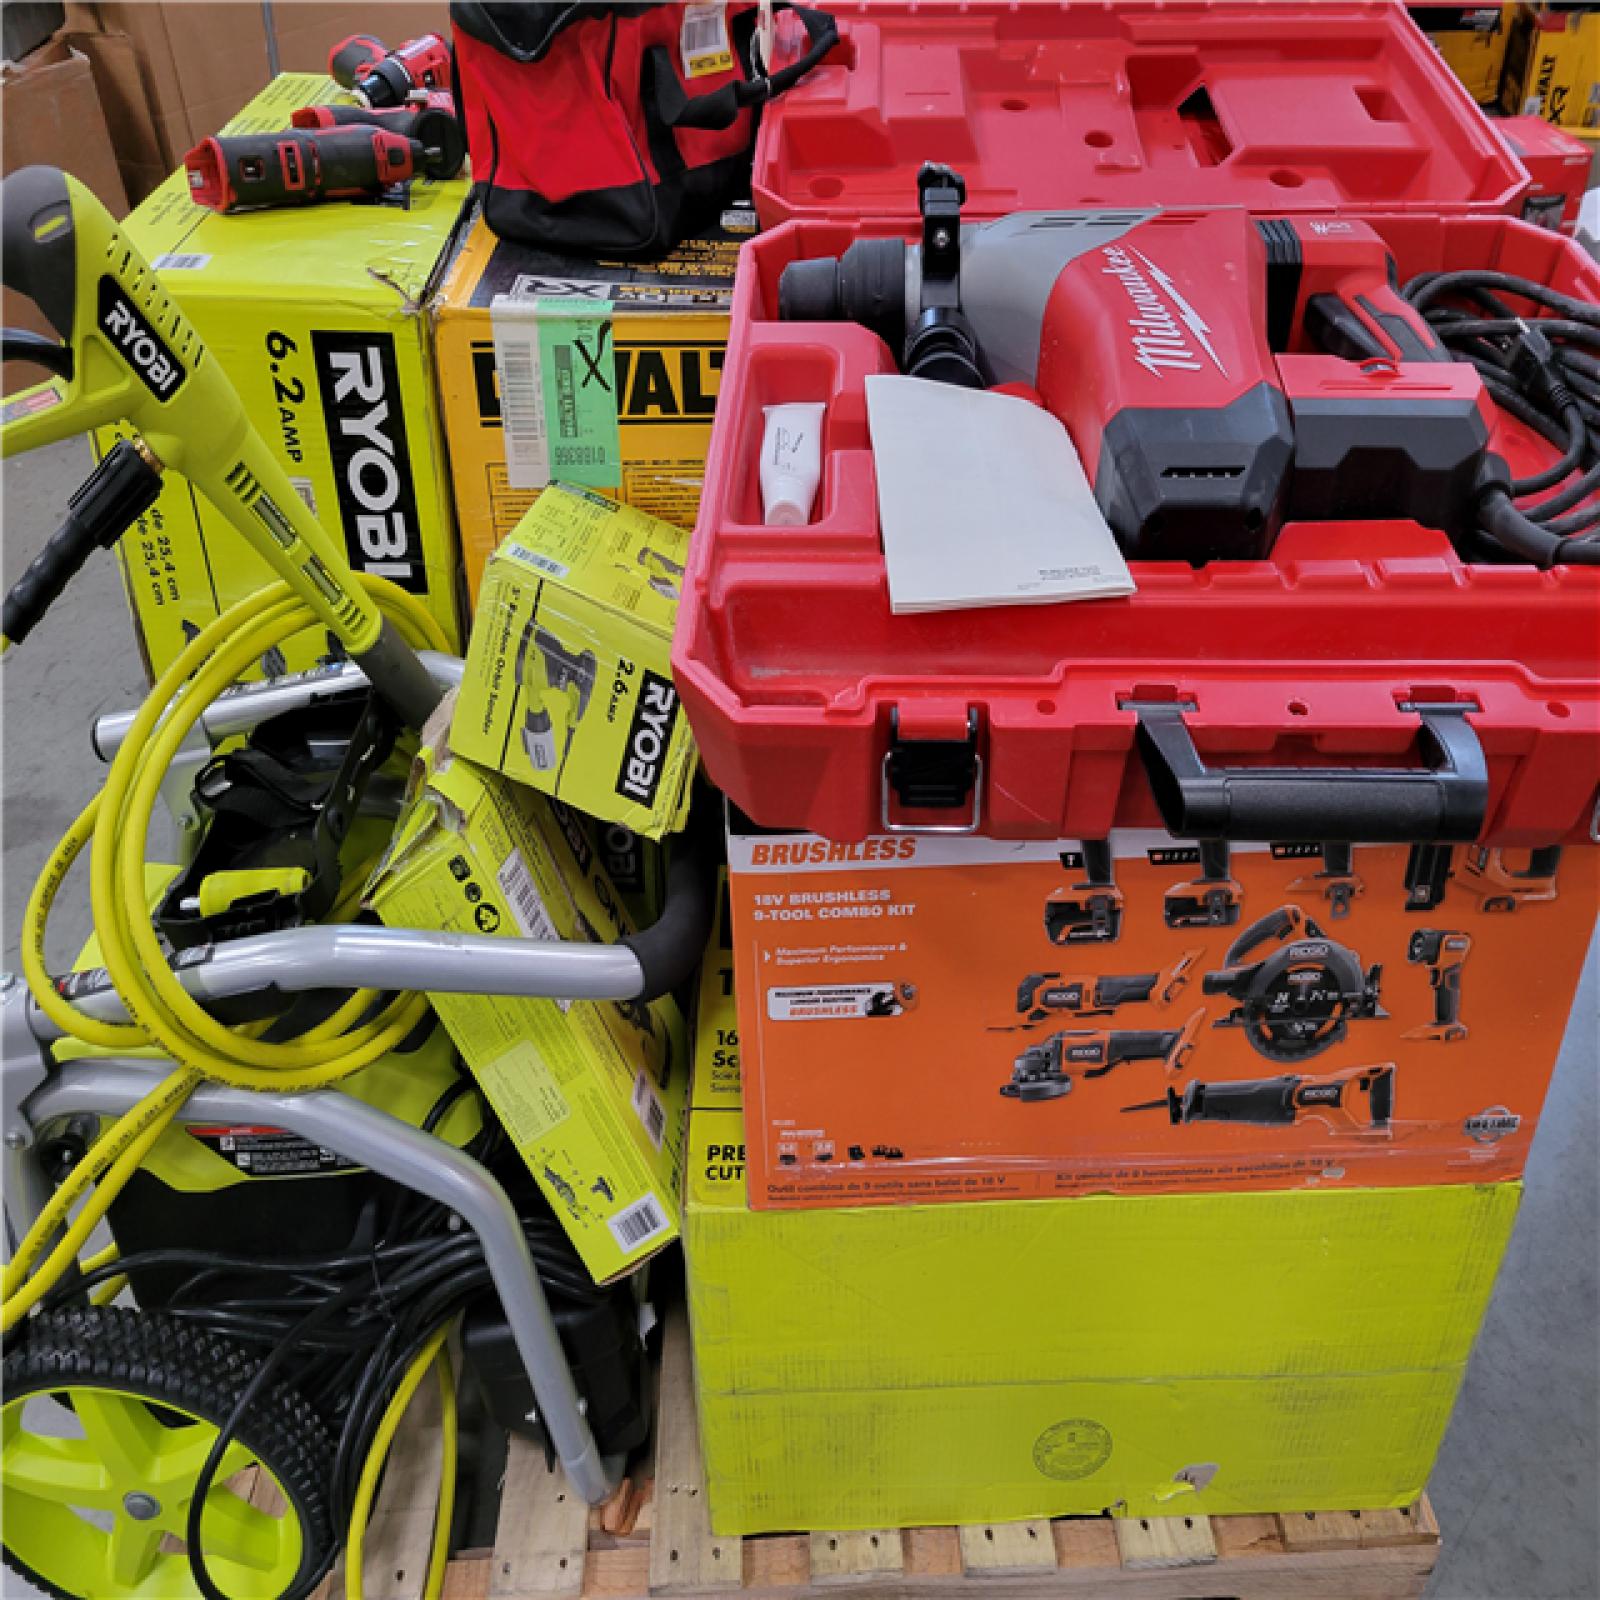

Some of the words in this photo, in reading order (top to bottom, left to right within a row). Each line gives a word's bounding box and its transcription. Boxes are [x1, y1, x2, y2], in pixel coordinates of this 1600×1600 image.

[105, 300, 179, 390] RYOBI
[1102, 246, 1200, 378] Milwaukee
[329, 347, 413, 577] RYOBI
[625, 683, 674, 797] RYOBI
[751, 837, 916, 865] BRUSHLESS
[754, 894, 784, 906] 18V
[789, 889, 891, 905] BRUSHLESS
[819, 905, 883, 919] COMBO
[887, 903, 916, 916] KIT
